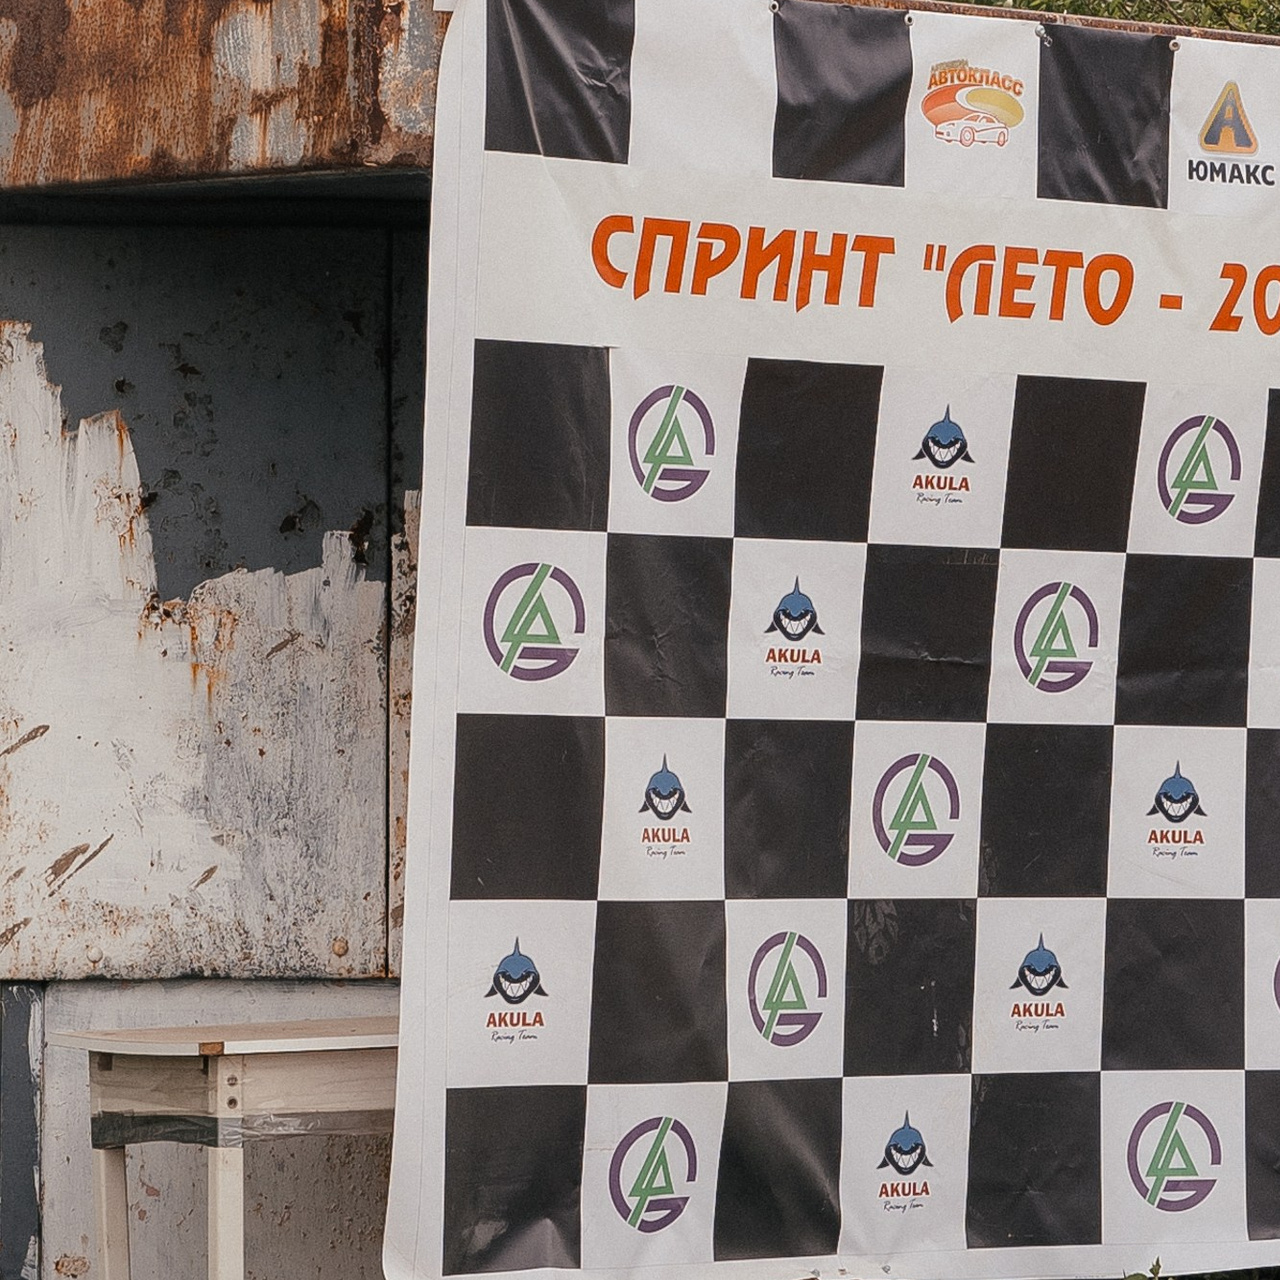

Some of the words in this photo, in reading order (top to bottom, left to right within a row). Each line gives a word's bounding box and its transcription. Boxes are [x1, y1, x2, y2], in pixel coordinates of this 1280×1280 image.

[928, 64, 1024, 96] АВТОКЛАСС
[1188, 159, 1276, 186] ЮМАКС
[591, 214, 896, 313] СПРИНТ
[923, 243, 1135, 326] "ЛЕТО
[1159, 294, 1184, 311] -
[912, 474, 970, 492] AKULA
[766, 647, 822, 664] AKULA
[642, 828, 691, 843] AKULA
[1148, 829, 1204, 844] AKULA
[1012, 1002, 1065, 1018] AKULA
[487, 1011, 544, 1028] AKULA
[879, 1181, 930, 1198] AKULA
